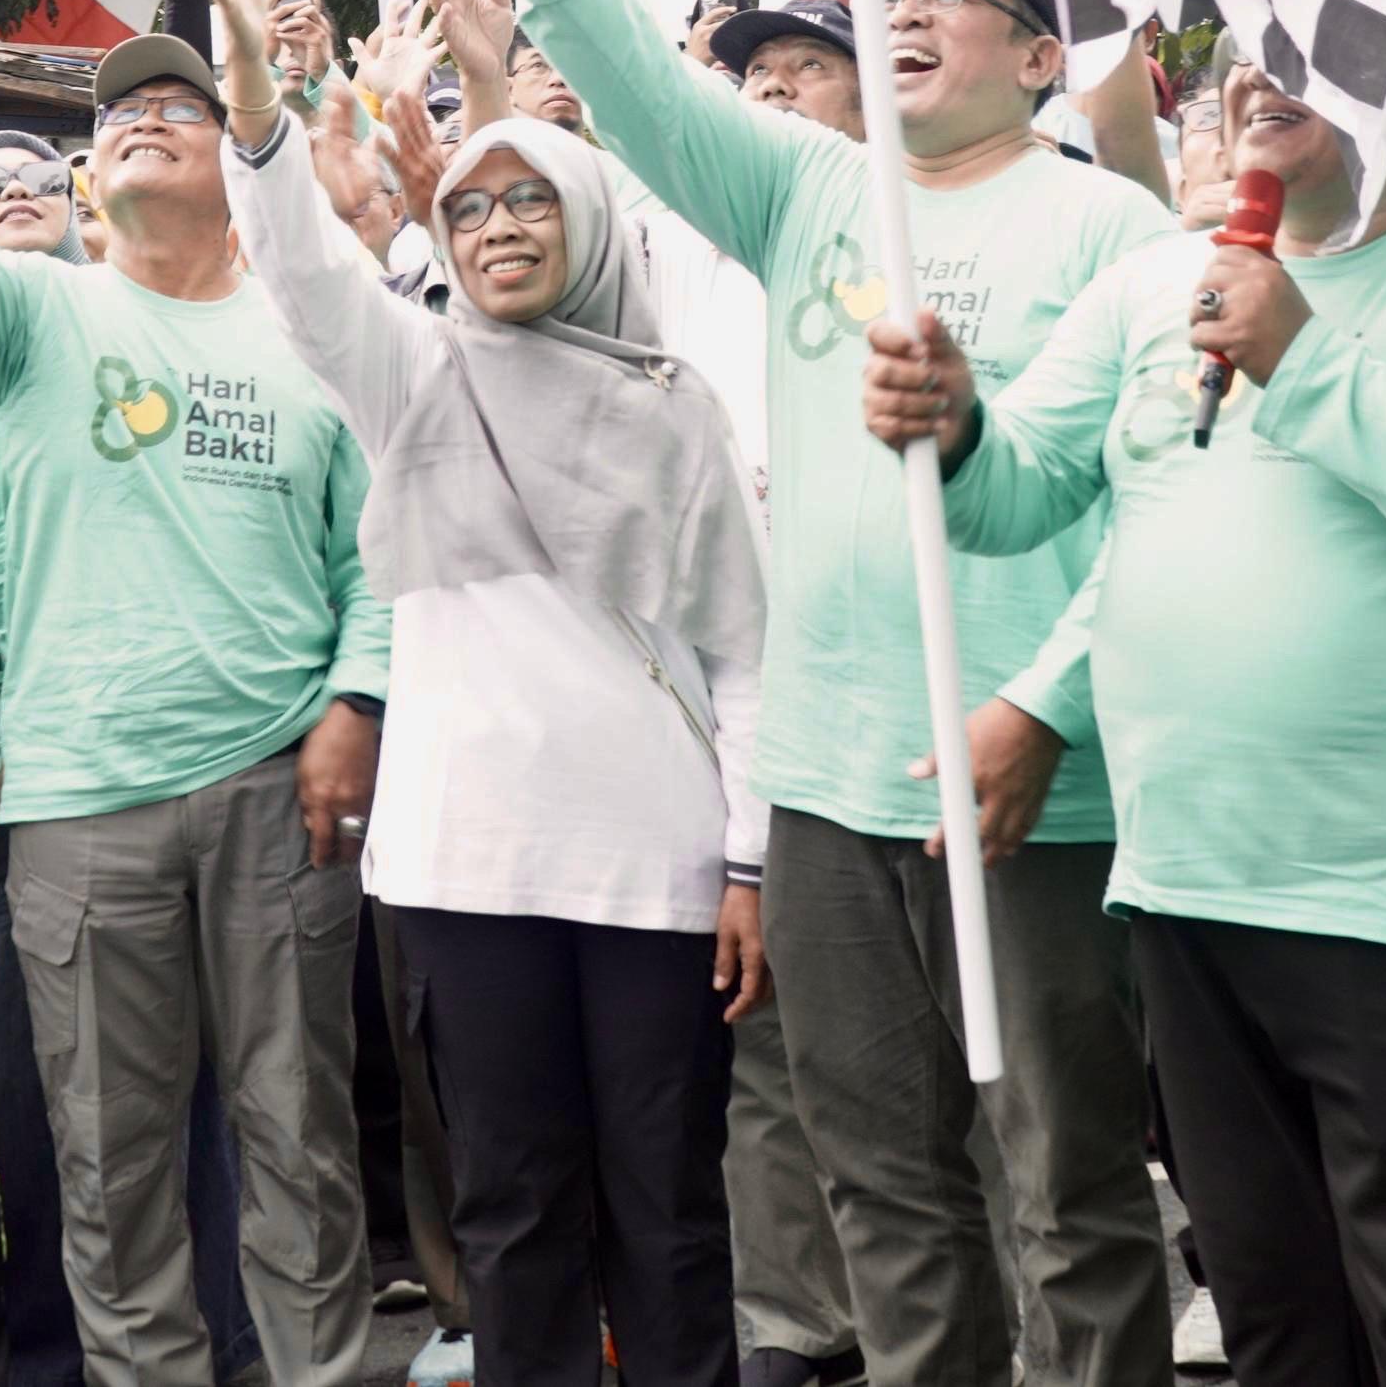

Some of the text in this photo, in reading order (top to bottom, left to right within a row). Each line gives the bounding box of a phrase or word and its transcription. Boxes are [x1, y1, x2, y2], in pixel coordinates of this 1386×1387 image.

[924, 286, 992, 314] mal
[186, 372, 256, 403] Hari
[184, 399, 276, 436] Amal
[184, 429, 275, 466] Bakti
